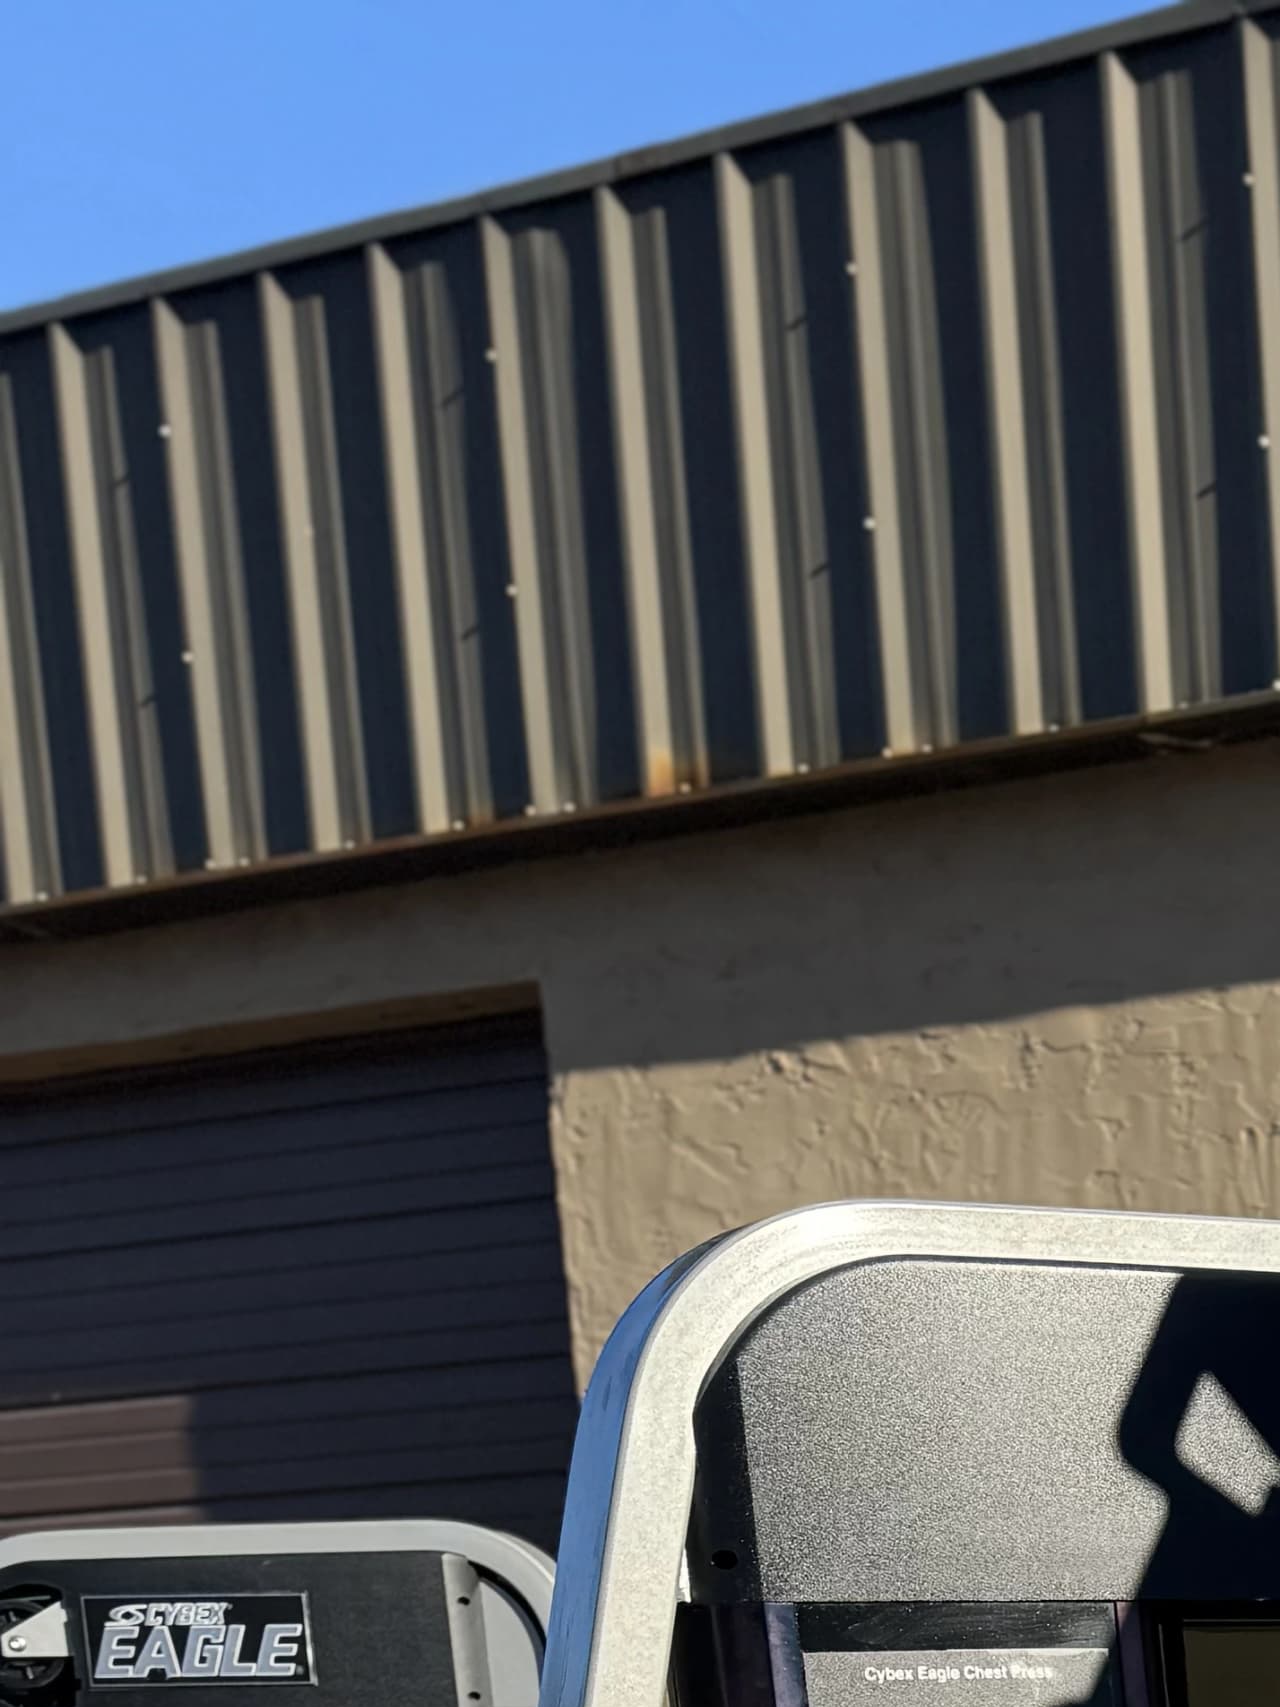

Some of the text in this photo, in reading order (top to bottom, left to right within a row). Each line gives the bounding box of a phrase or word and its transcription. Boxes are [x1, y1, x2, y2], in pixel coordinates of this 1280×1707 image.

[145, 1603, 227, 1625] CYBEX
[94, 1624, 302, 1678] EAGLE
[865, 1664, 1053, 1684] Cybex Eagle Chest Press
